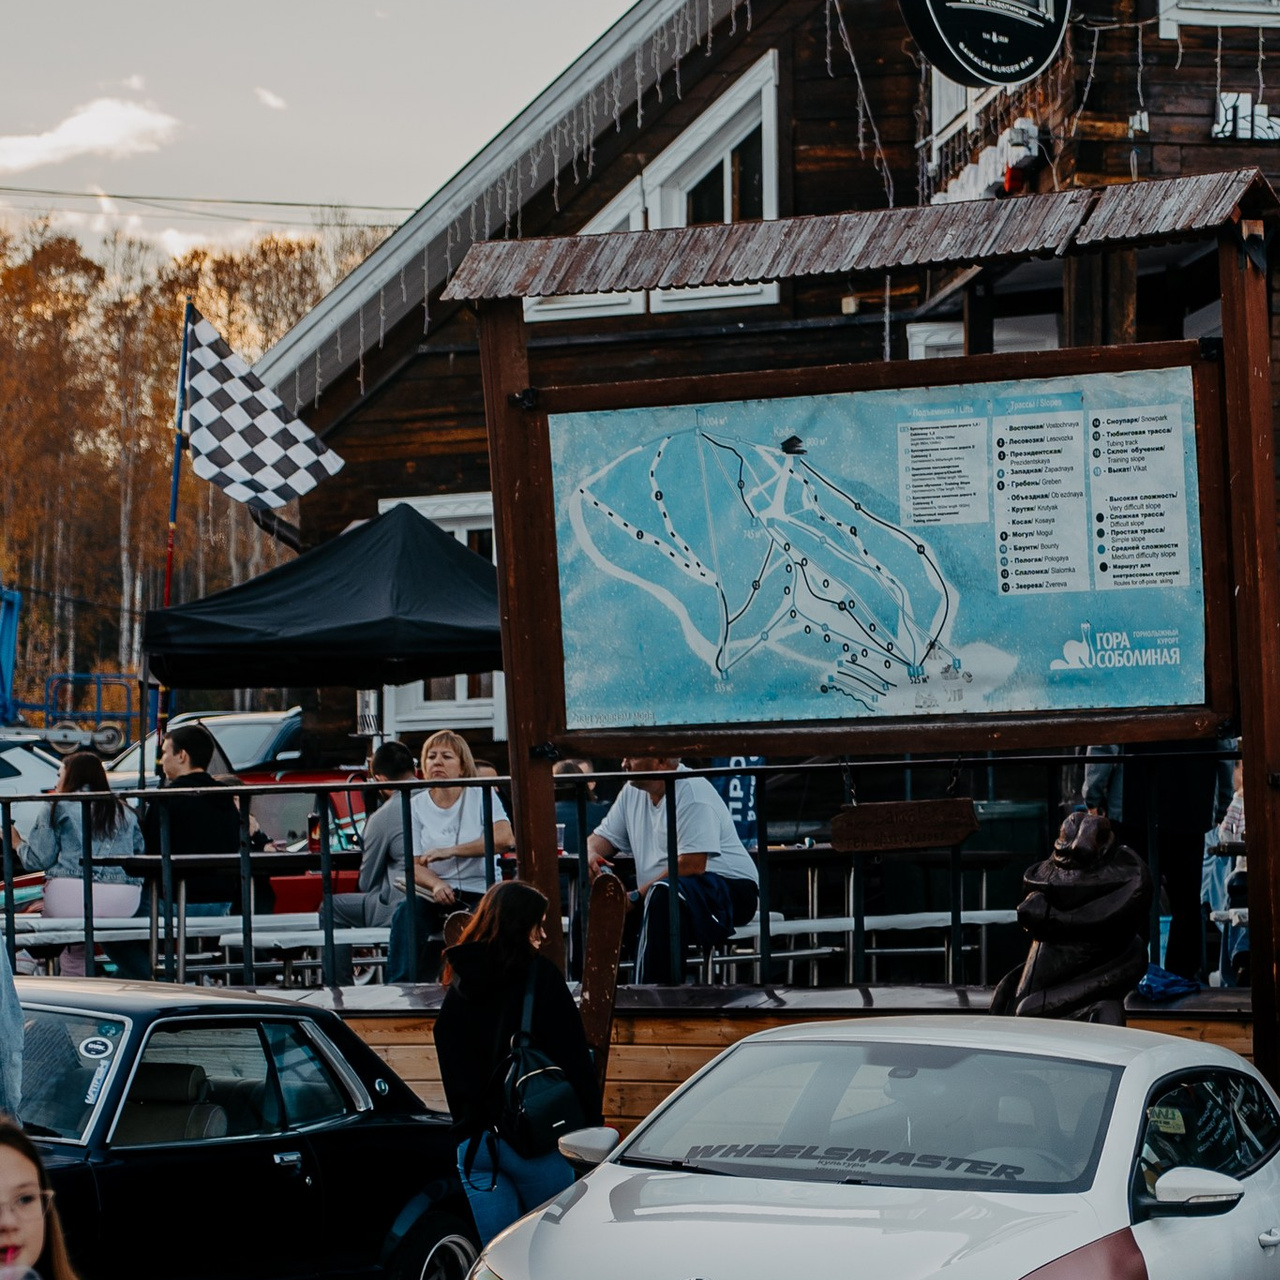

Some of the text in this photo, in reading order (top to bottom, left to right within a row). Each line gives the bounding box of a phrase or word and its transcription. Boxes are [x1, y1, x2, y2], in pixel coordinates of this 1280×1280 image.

[991, 64, 1020, 74] BURGER
[1019, 56, 1034, 70] BAR
[1106, 440, 1124, 448] Tubing
[1108, 456, 1130, 464] Training
[1146, 502, 1161, 511] slope
[1130, 520, 1144, 528] slope
[1130, 536, 1146, 544] slope
[1136, 551, 1160, 560] difficulty
[1160, 550, 1176, 558] slope
[1097, 632, 1130, 650] ГОРА
[1097, 648, 1180, 668] СОБОЛИНАЯ
[685, 1143, 1026, 1180] WHEELSMASTER
